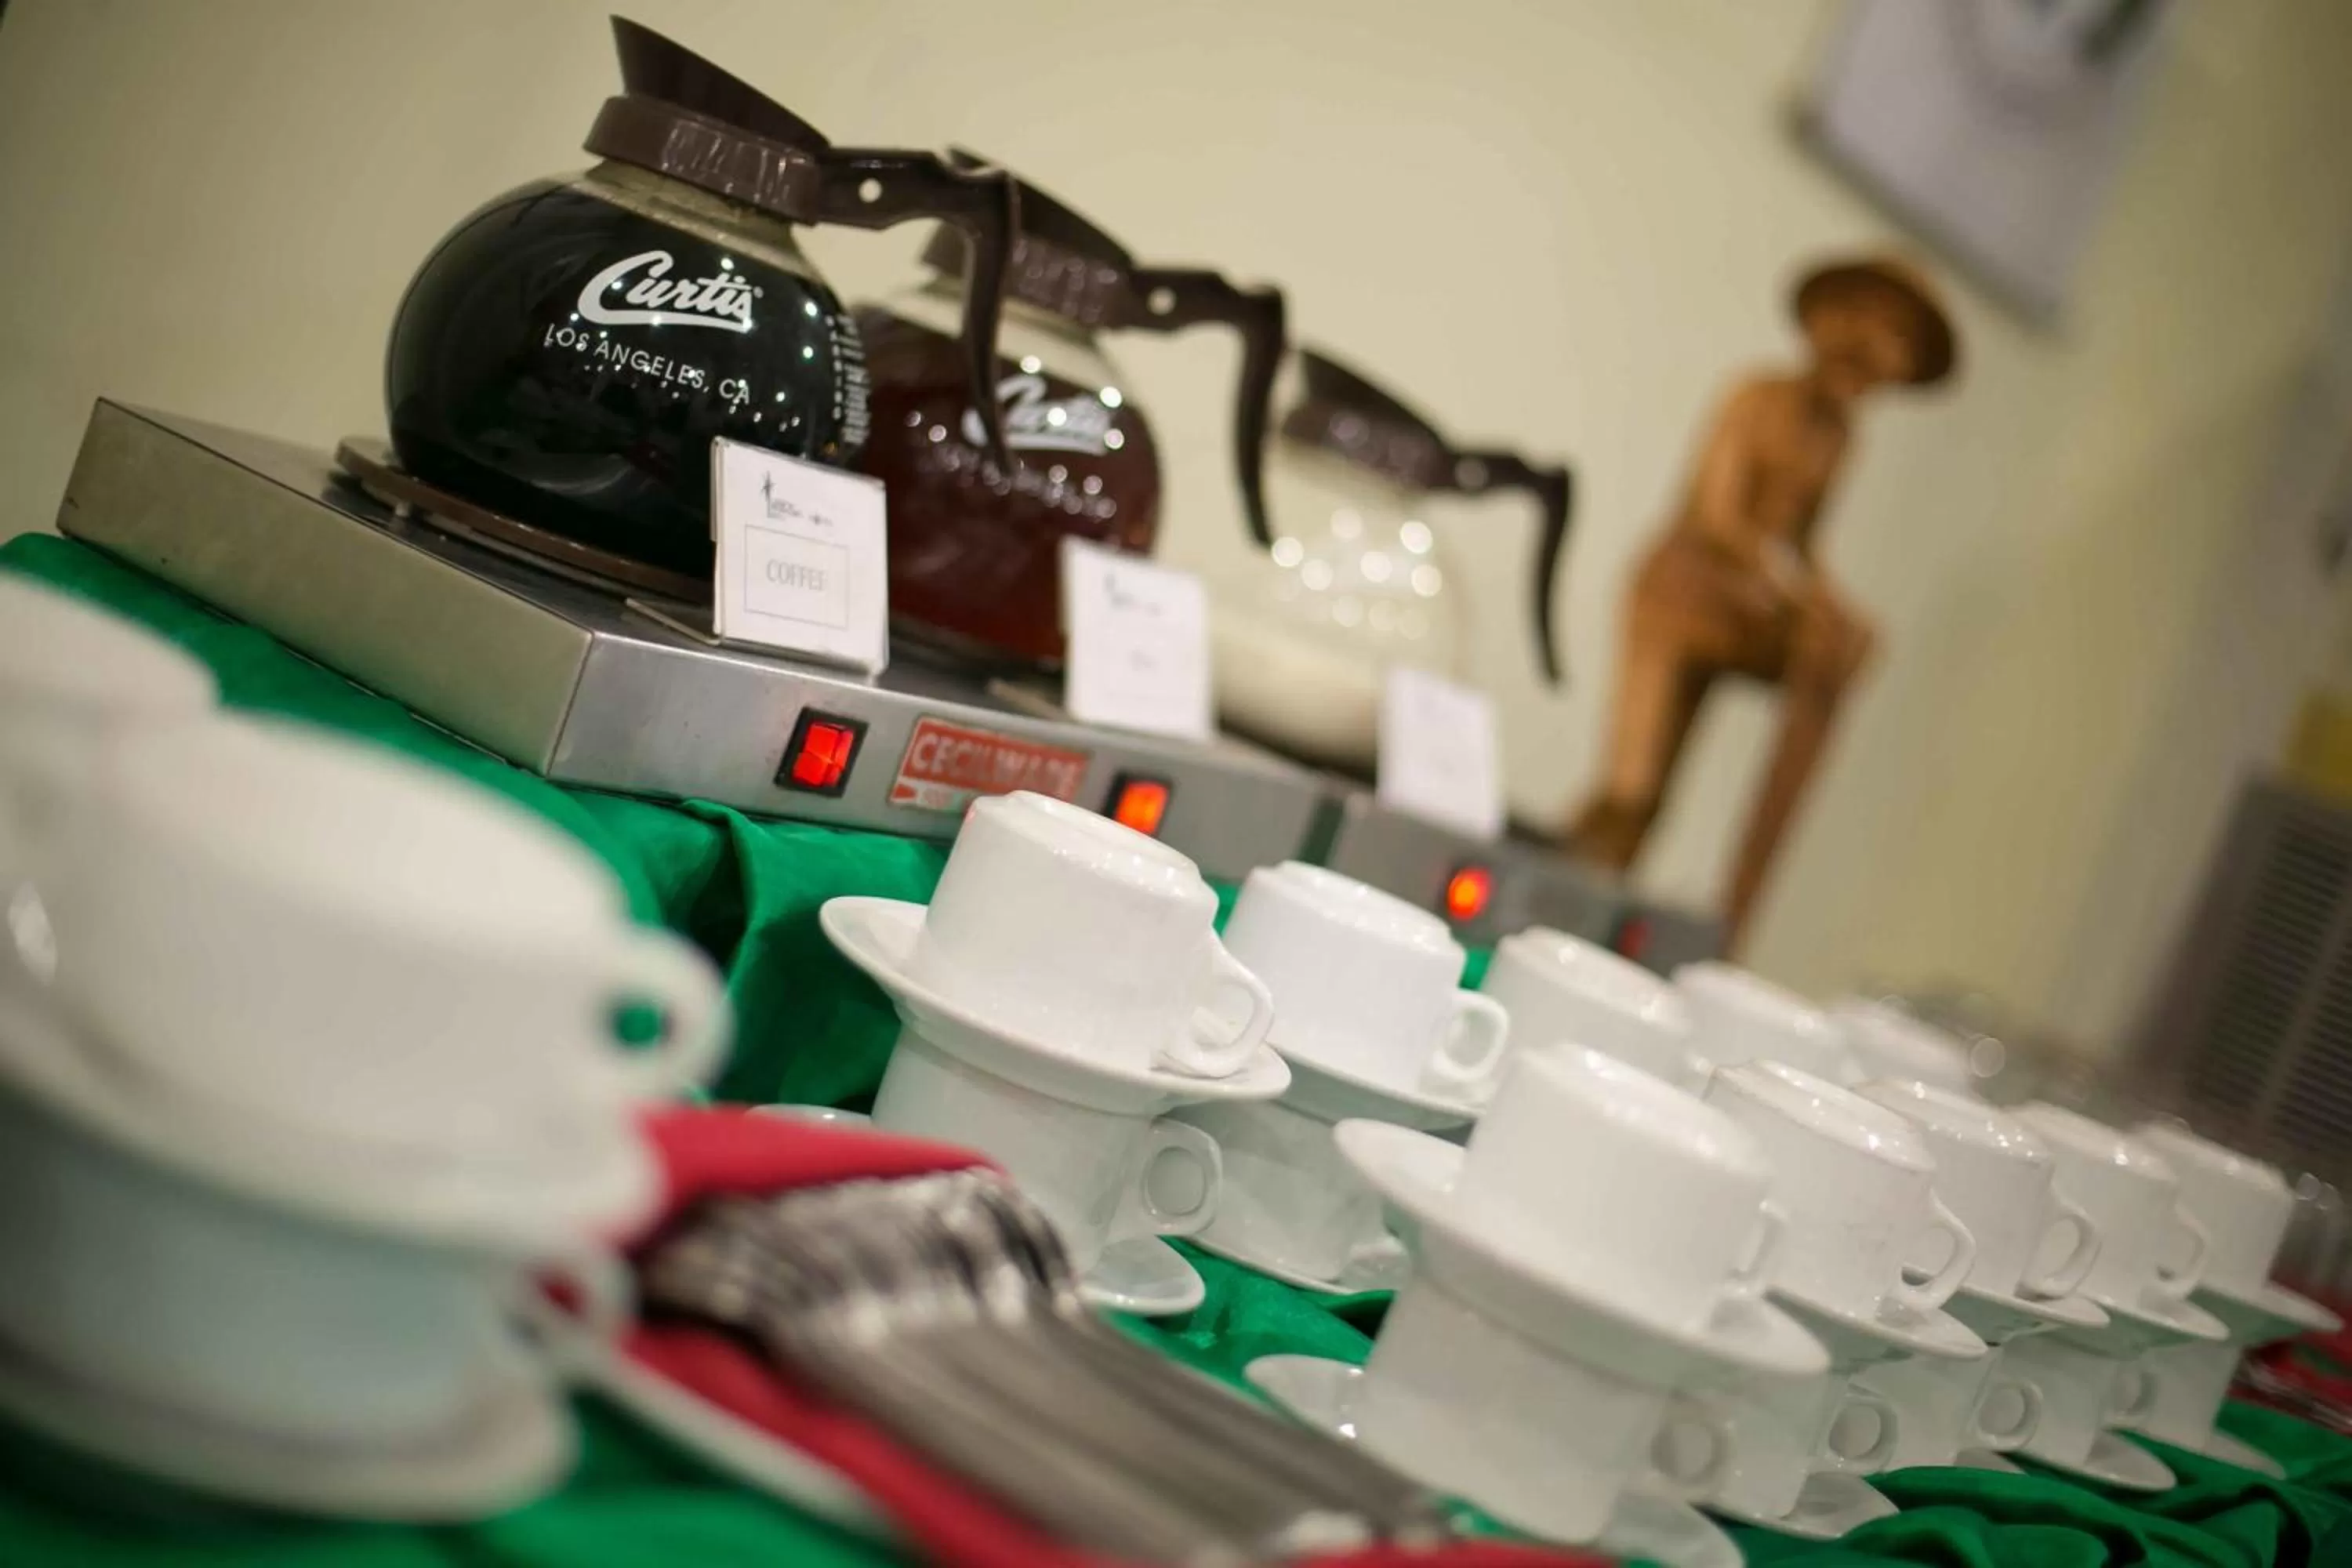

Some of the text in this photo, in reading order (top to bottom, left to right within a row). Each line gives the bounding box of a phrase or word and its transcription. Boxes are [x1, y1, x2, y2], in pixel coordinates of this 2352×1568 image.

[577, 249, 753, 334] Curtis
[544, 323, 750, 405] LOS ANGELES, CA
[765, 557, 829, 591] COFFEE
